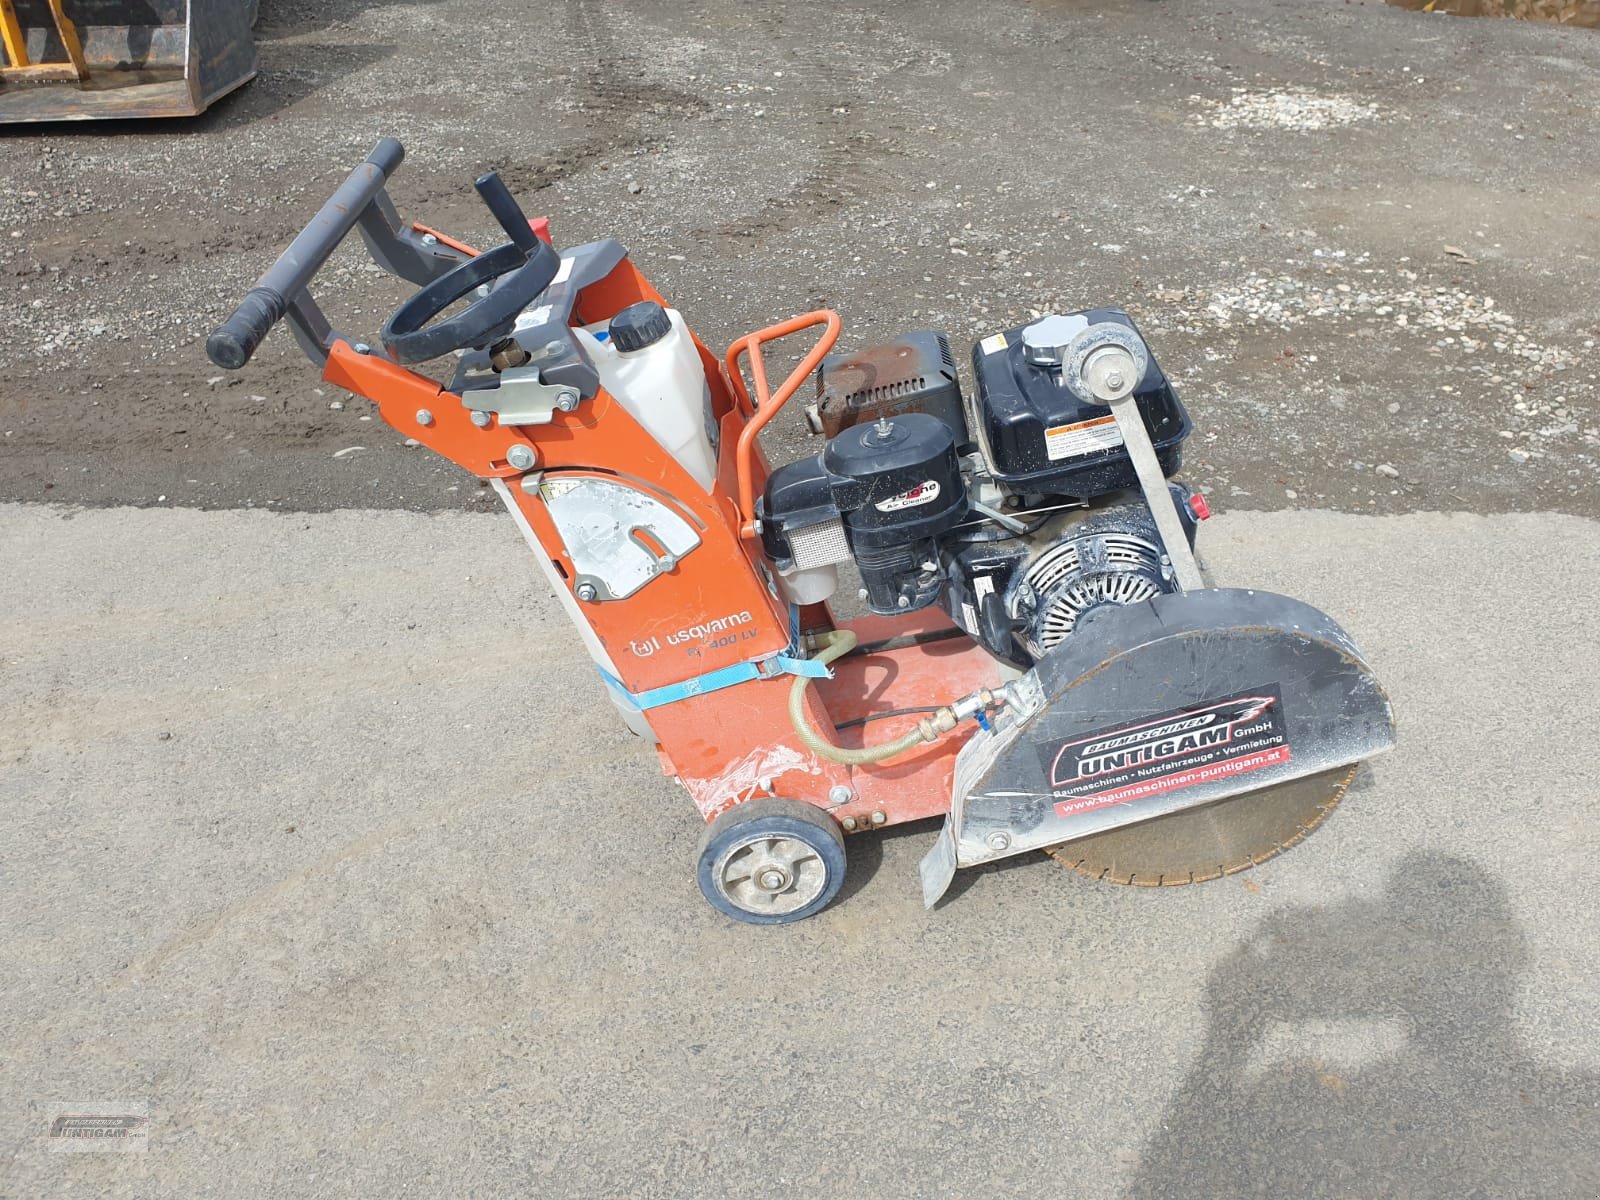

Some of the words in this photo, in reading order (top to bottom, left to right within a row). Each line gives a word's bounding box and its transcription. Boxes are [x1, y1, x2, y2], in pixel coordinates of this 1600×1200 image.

[710, 634, 737, 649] 400
[741, 628, 758, 641] LV
[1085, 714, 1212, 754] BAUMASCHINEN
[1233, 720, 1273, 739] GmbH
[1053, 774, 1129, 799] Baumaschinen
[1137, 752, 1214, 778] Nutzfahrzeuge
[1222, 734, 1284, 757] Vermietung
[1061, 751, 1282, 813] www.baumaschinen-puntigam.at
